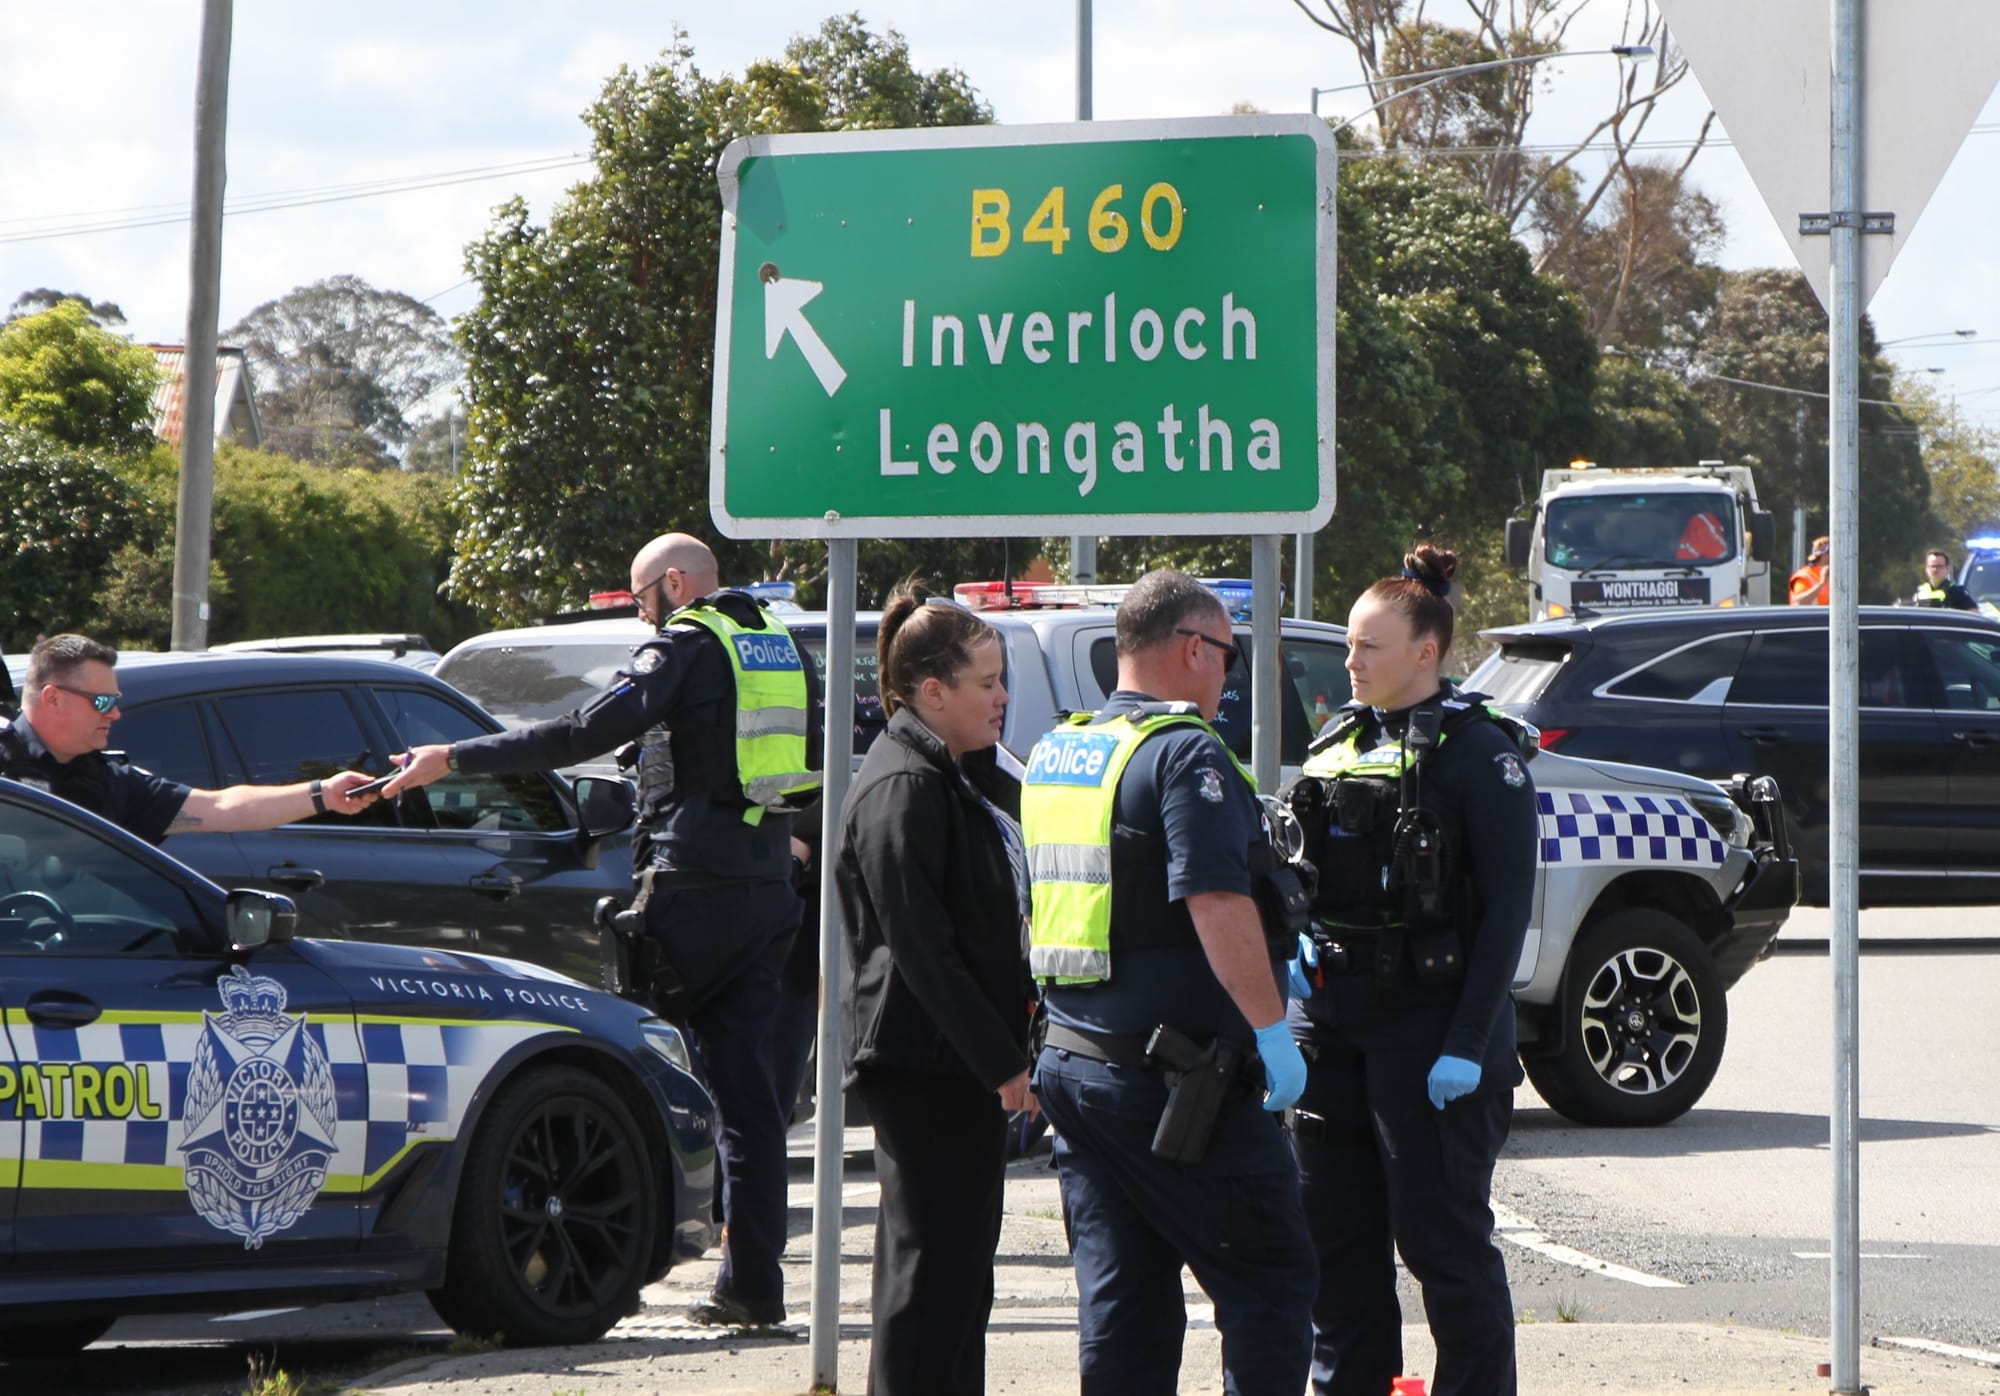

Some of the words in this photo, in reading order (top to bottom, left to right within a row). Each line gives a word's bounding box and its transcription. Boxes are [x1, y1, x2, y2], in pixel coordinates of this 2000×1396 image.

[969, 182, 1183, 257] B460
[902, 292, 1258, 367] Inverloch
[880, 403, 1281, 497] Leongatha
[1602, 581, 1679, 599] WONTHAGGI
[737, 639, 798, 665] Police
[1030, 740, 1105, 776] Police
[369, 976, 494, 1001] VICTORIA
[503, 988, 590, 1012] POLICE
[226, 1062, 297, 1109] VICTORIA
[229, 1130, 291, 1164] POLICE
[203, 1153, 242, 1191] UPHOLD
[245, 1183, 269, 1196] THE
[273, 1155, 310, 1187] RIGHT
